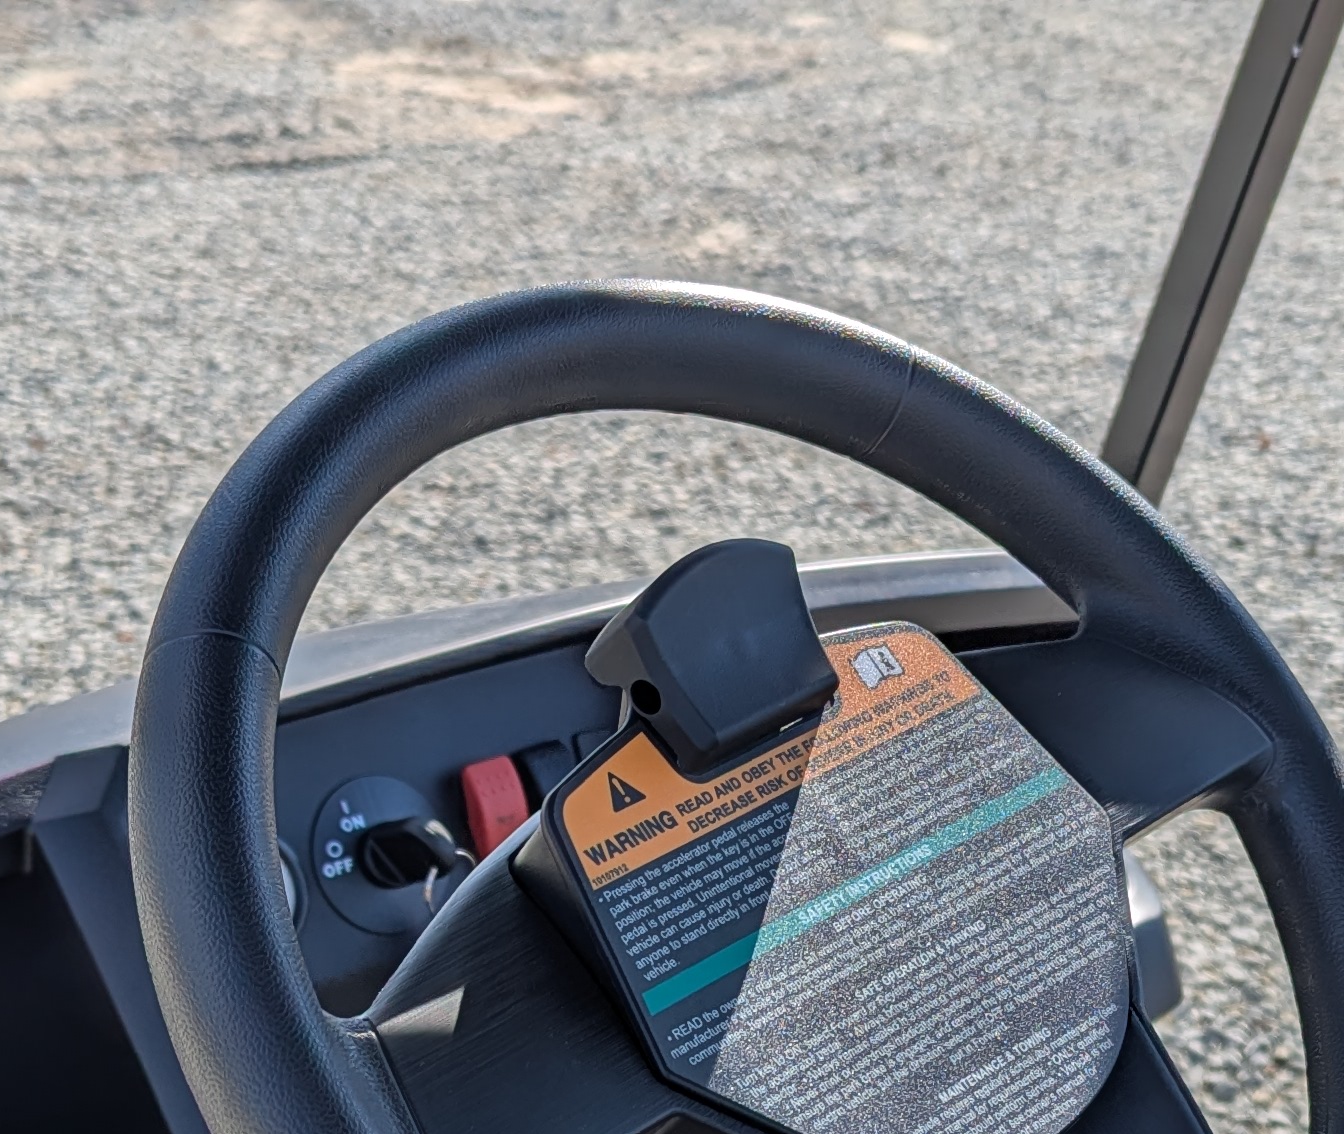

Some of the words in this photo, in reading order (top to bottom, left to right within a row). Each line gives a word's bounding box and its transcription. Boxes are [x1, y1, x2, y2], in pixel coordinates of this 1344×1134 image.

[675, 789, 714, 817] READ
[711, 775, 741, 799] AND
[739, 756, 778, 784] OBEY
[773, 743, 803, 767] THE
[686, 788, 757, 834] DECREASE
[754, 773, 788, 799] RISK
[785, 763, 806, 783] OF
[340, 814, 366, 833] ON
[583, 807, 678, 868] WARNING
[602, 873, 647, 905] Pressing
[643, 864, 662, 880] the
[659, 838, 711, 872] accelerator
[709, 825, 738, 849] pedal
[734, 806, 774, 833] releases
[772, 798, 789, 814] the
[322, 857, 354, 879] OFF
[608, 897, 634, 919] park
[629, 882, 659, 905] brake
[658, 872, 682, 890] even
[680, 856, 708, 878] when
[706, 849, 723, 864] the
[721, 839, 742, 859] key
[738, 835, 749, 847] is
[747, 830, 759, 843] in
[757, 821, 774, 837] the
[772, 810, 795, 830] OFF
[653, 893, 671, 909] the
[668, 875, 703, 901] vehicle
[703, 867, 725, 886] may
[723, 854, 749, 873] move
[747, 847, 757, 859] if
[754, 839, 771, 855] the
[797, 889, 847, 925] SAFETY
[845, 841, 933, 899] INSTRUCTIONS
[832, 901, 875, 932] BEFORE
[872, 872, 927, 910] OPERATING
[619, 921, 650, 946] pedal
[646, 916, 658, 929] is
[656, 895, 699, 927] pressed.
[696, 865, 755, 903] Unintentional
[624, 931, 660, 957] vehicle
[659, 923, 679, 939] can
[678, 908, 707, 929] cause
[704, 893, 733, 917] injury
[731, 889, 743, 900] or
[741, 872, 771, 894] death.
[634, 945, 672, 972] anyone
[668, 937, 681, 951] to
[678, 922, 707, 945] stand
[705, 905, 741, 933] directly
[737, 899, 750, 913] in
[747, 888, 770, 908] front
[642, 954, 680, 981] vehicle.
[853, 978, 882, 1002] SAFE
[880, 946, 936, 986] OPERATION
[933, 942, 944, 954] &
[942, 918, 986, 949] PARKING
[669, 1012, 739, 1059] manufacturer's
[671, 1015, 703, 1040] READ
[701, 1006, 719, 1023] the
[937, 1091, 976, 1123] requires
[1048, 1011, 1099, 1051] maintenance
[1096, 1000, 1119, 1022] (see
[937, 1055, 1007, 1103] MAINTENANCE
[1004, 1049, 1015, 1062] &
[1012, 1026, 1052, 1057] TOWING
[973, 1100, 988, 1116] for
[1050, 1041, 1078, 1066] ONLY
[1074, 1021, 1111, 1053] qualified
[992, 1093, 1028, 1124] perform
[1088, 1044, 1100, 1058] is
[1097, 1035, 1114, 1052] not
[1054, 1070, 1087, 1097] manual
[1084, 1063, 1097, 1078] for
